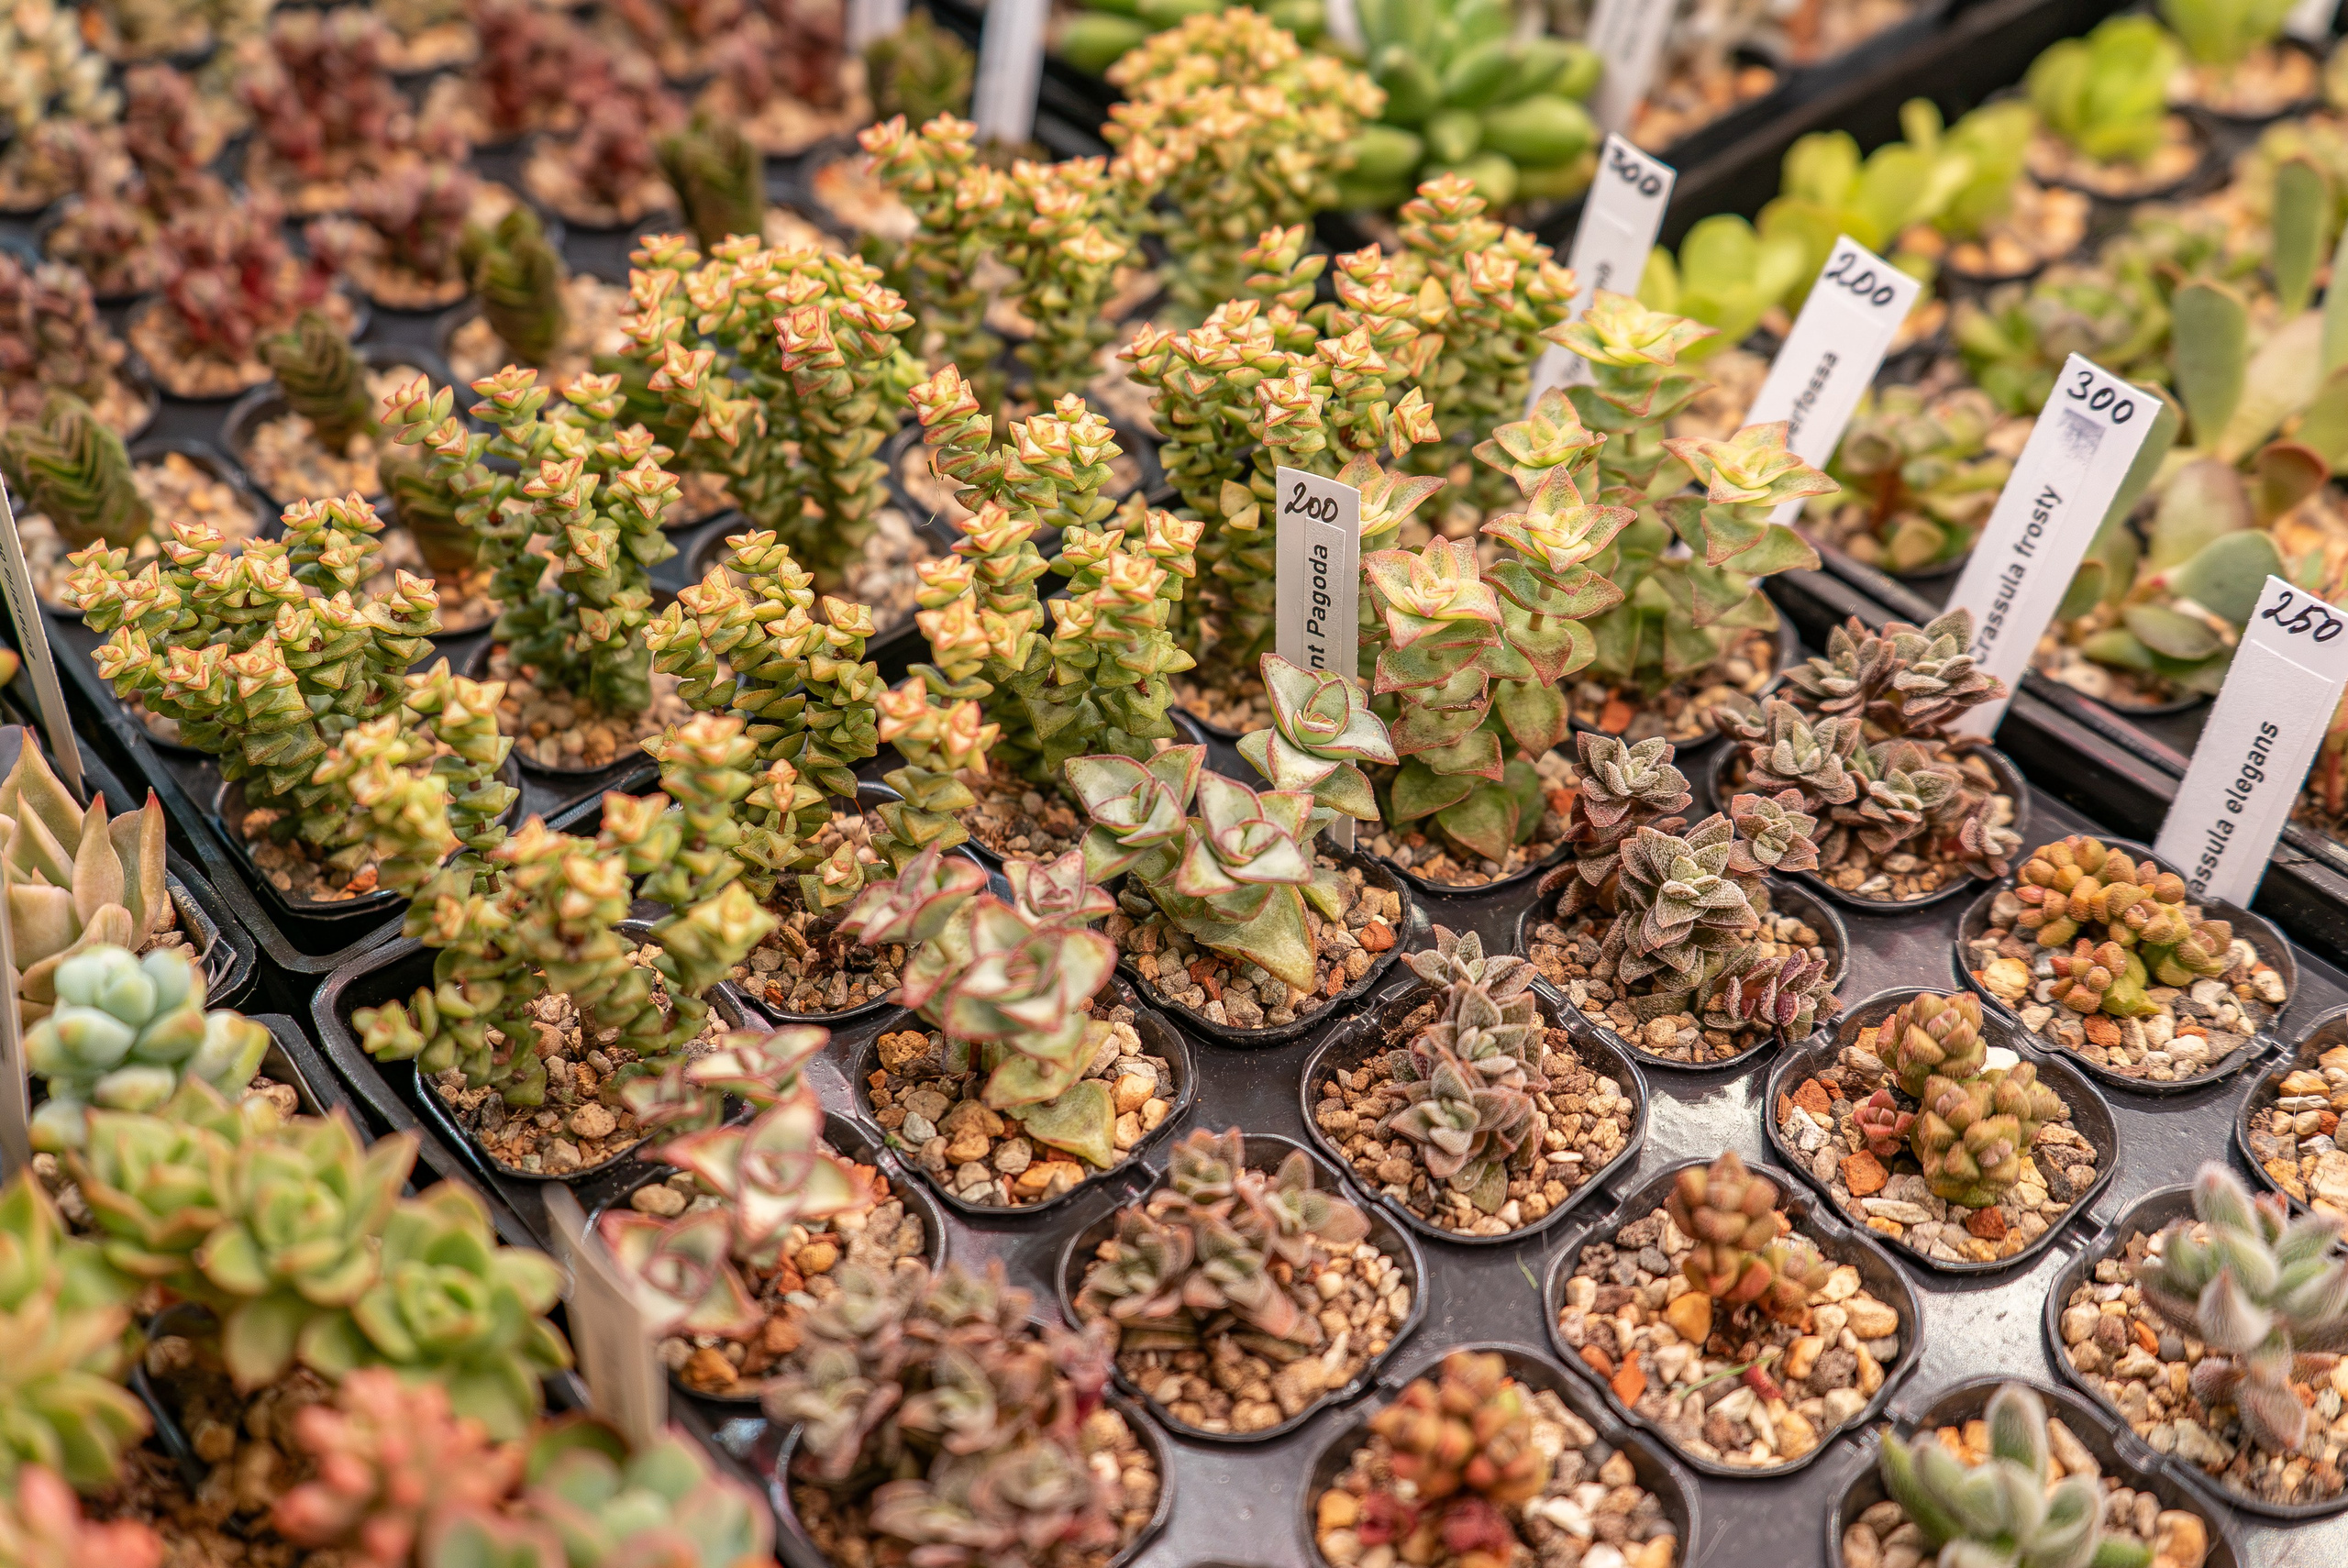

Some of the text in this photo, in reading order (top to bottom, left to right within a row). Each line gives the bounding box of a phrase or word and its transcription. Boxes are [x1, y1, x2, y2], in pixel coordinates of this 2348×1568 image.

[1610, 146, 1662, 196] 300
[1825, 252, 1895, 306] 200
[2066, 370, 2134, 425] 300
[1284, 481, 1338, 523] 200
[2012, 484, 2064, 558] frosty
[1307, 544, 1331, 670] nt Pagoda
[2262, 591, 2343, 643] 250
[2224, 720, 2279, 815] elegans
